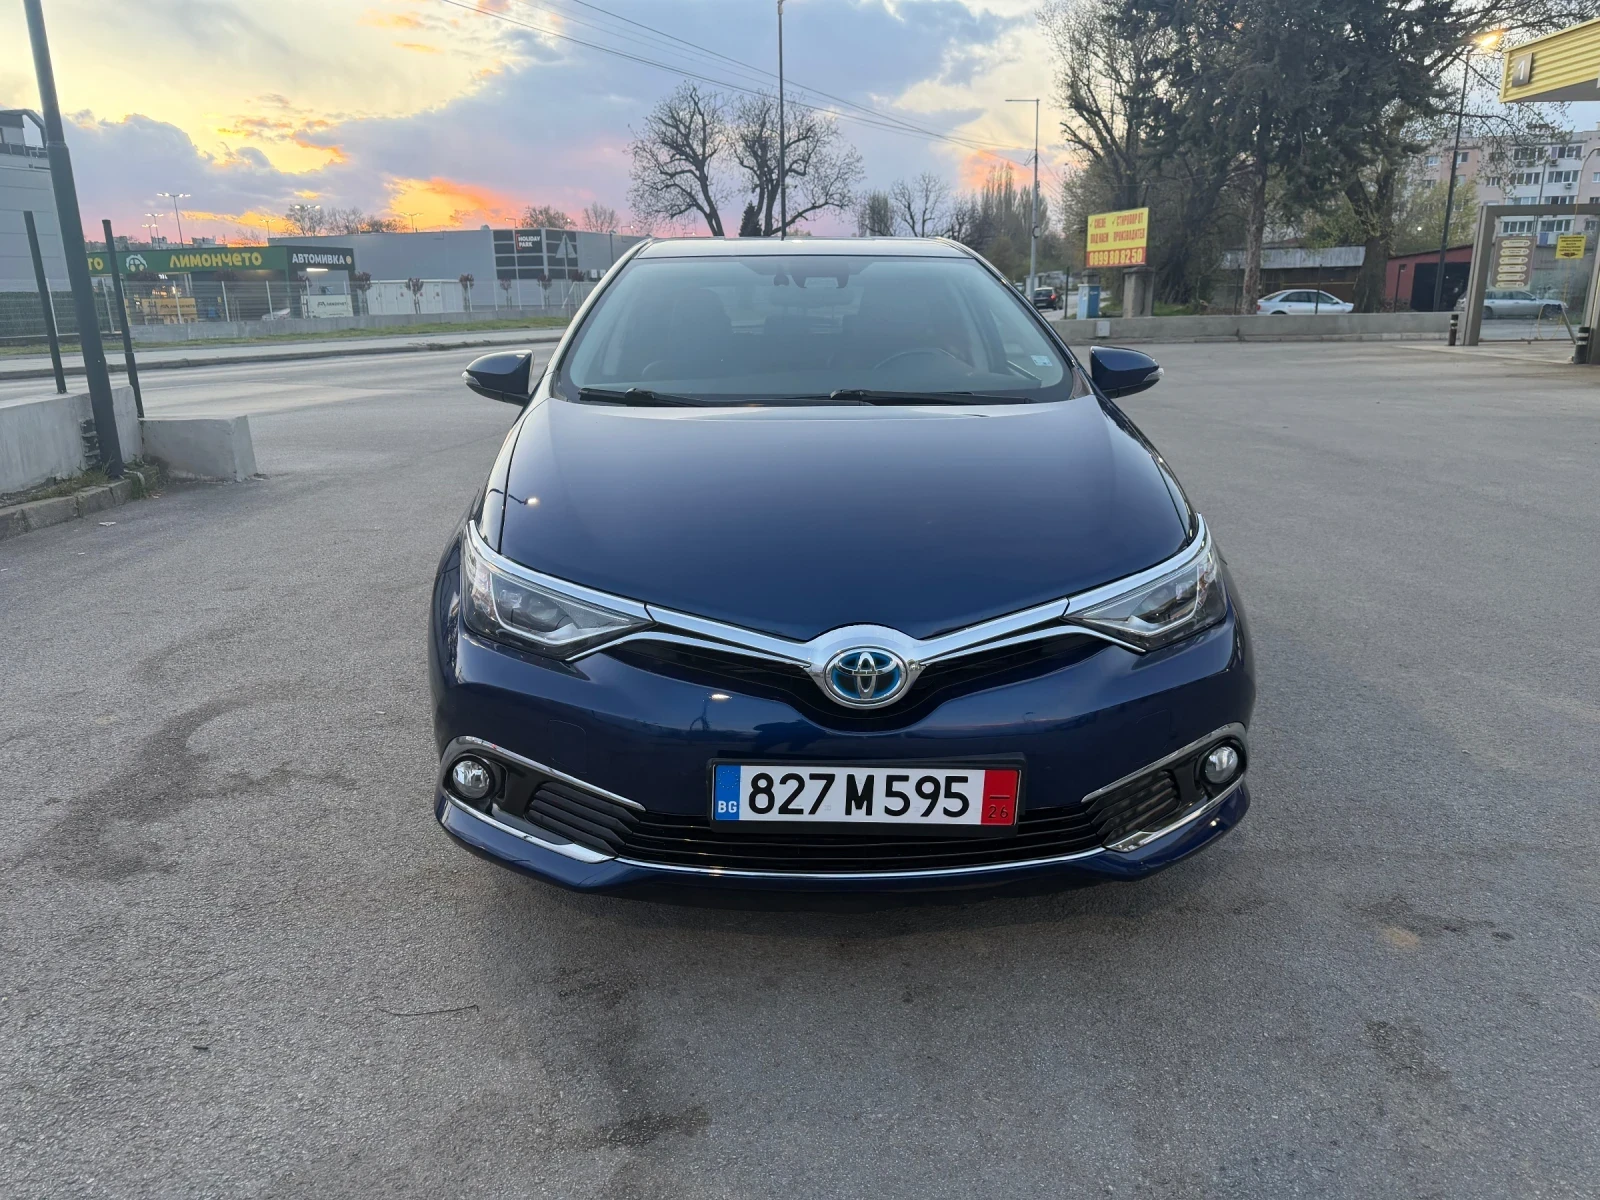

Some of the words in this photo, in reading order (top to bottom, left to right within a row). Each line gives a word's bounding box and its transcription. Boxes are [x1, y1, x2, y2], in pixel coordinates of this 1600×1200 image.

[1517, 60, 1526, 80] 1
[291, 252, 345, 265] АВТОМИВКА
[1089, 251, 1108, 266] 0899
[1109, 250, 1119, 265] 80
[1120, 249, 1130, 264] 82
[1131, 248, 1142, 263] 50
[748, 772, 836, 815] 827
[844, 774, 875, 816] M
[883, 774, 970, 818] 595
[717, 800, 738, 813] BG
[988, 804, 1009, 818] 26
